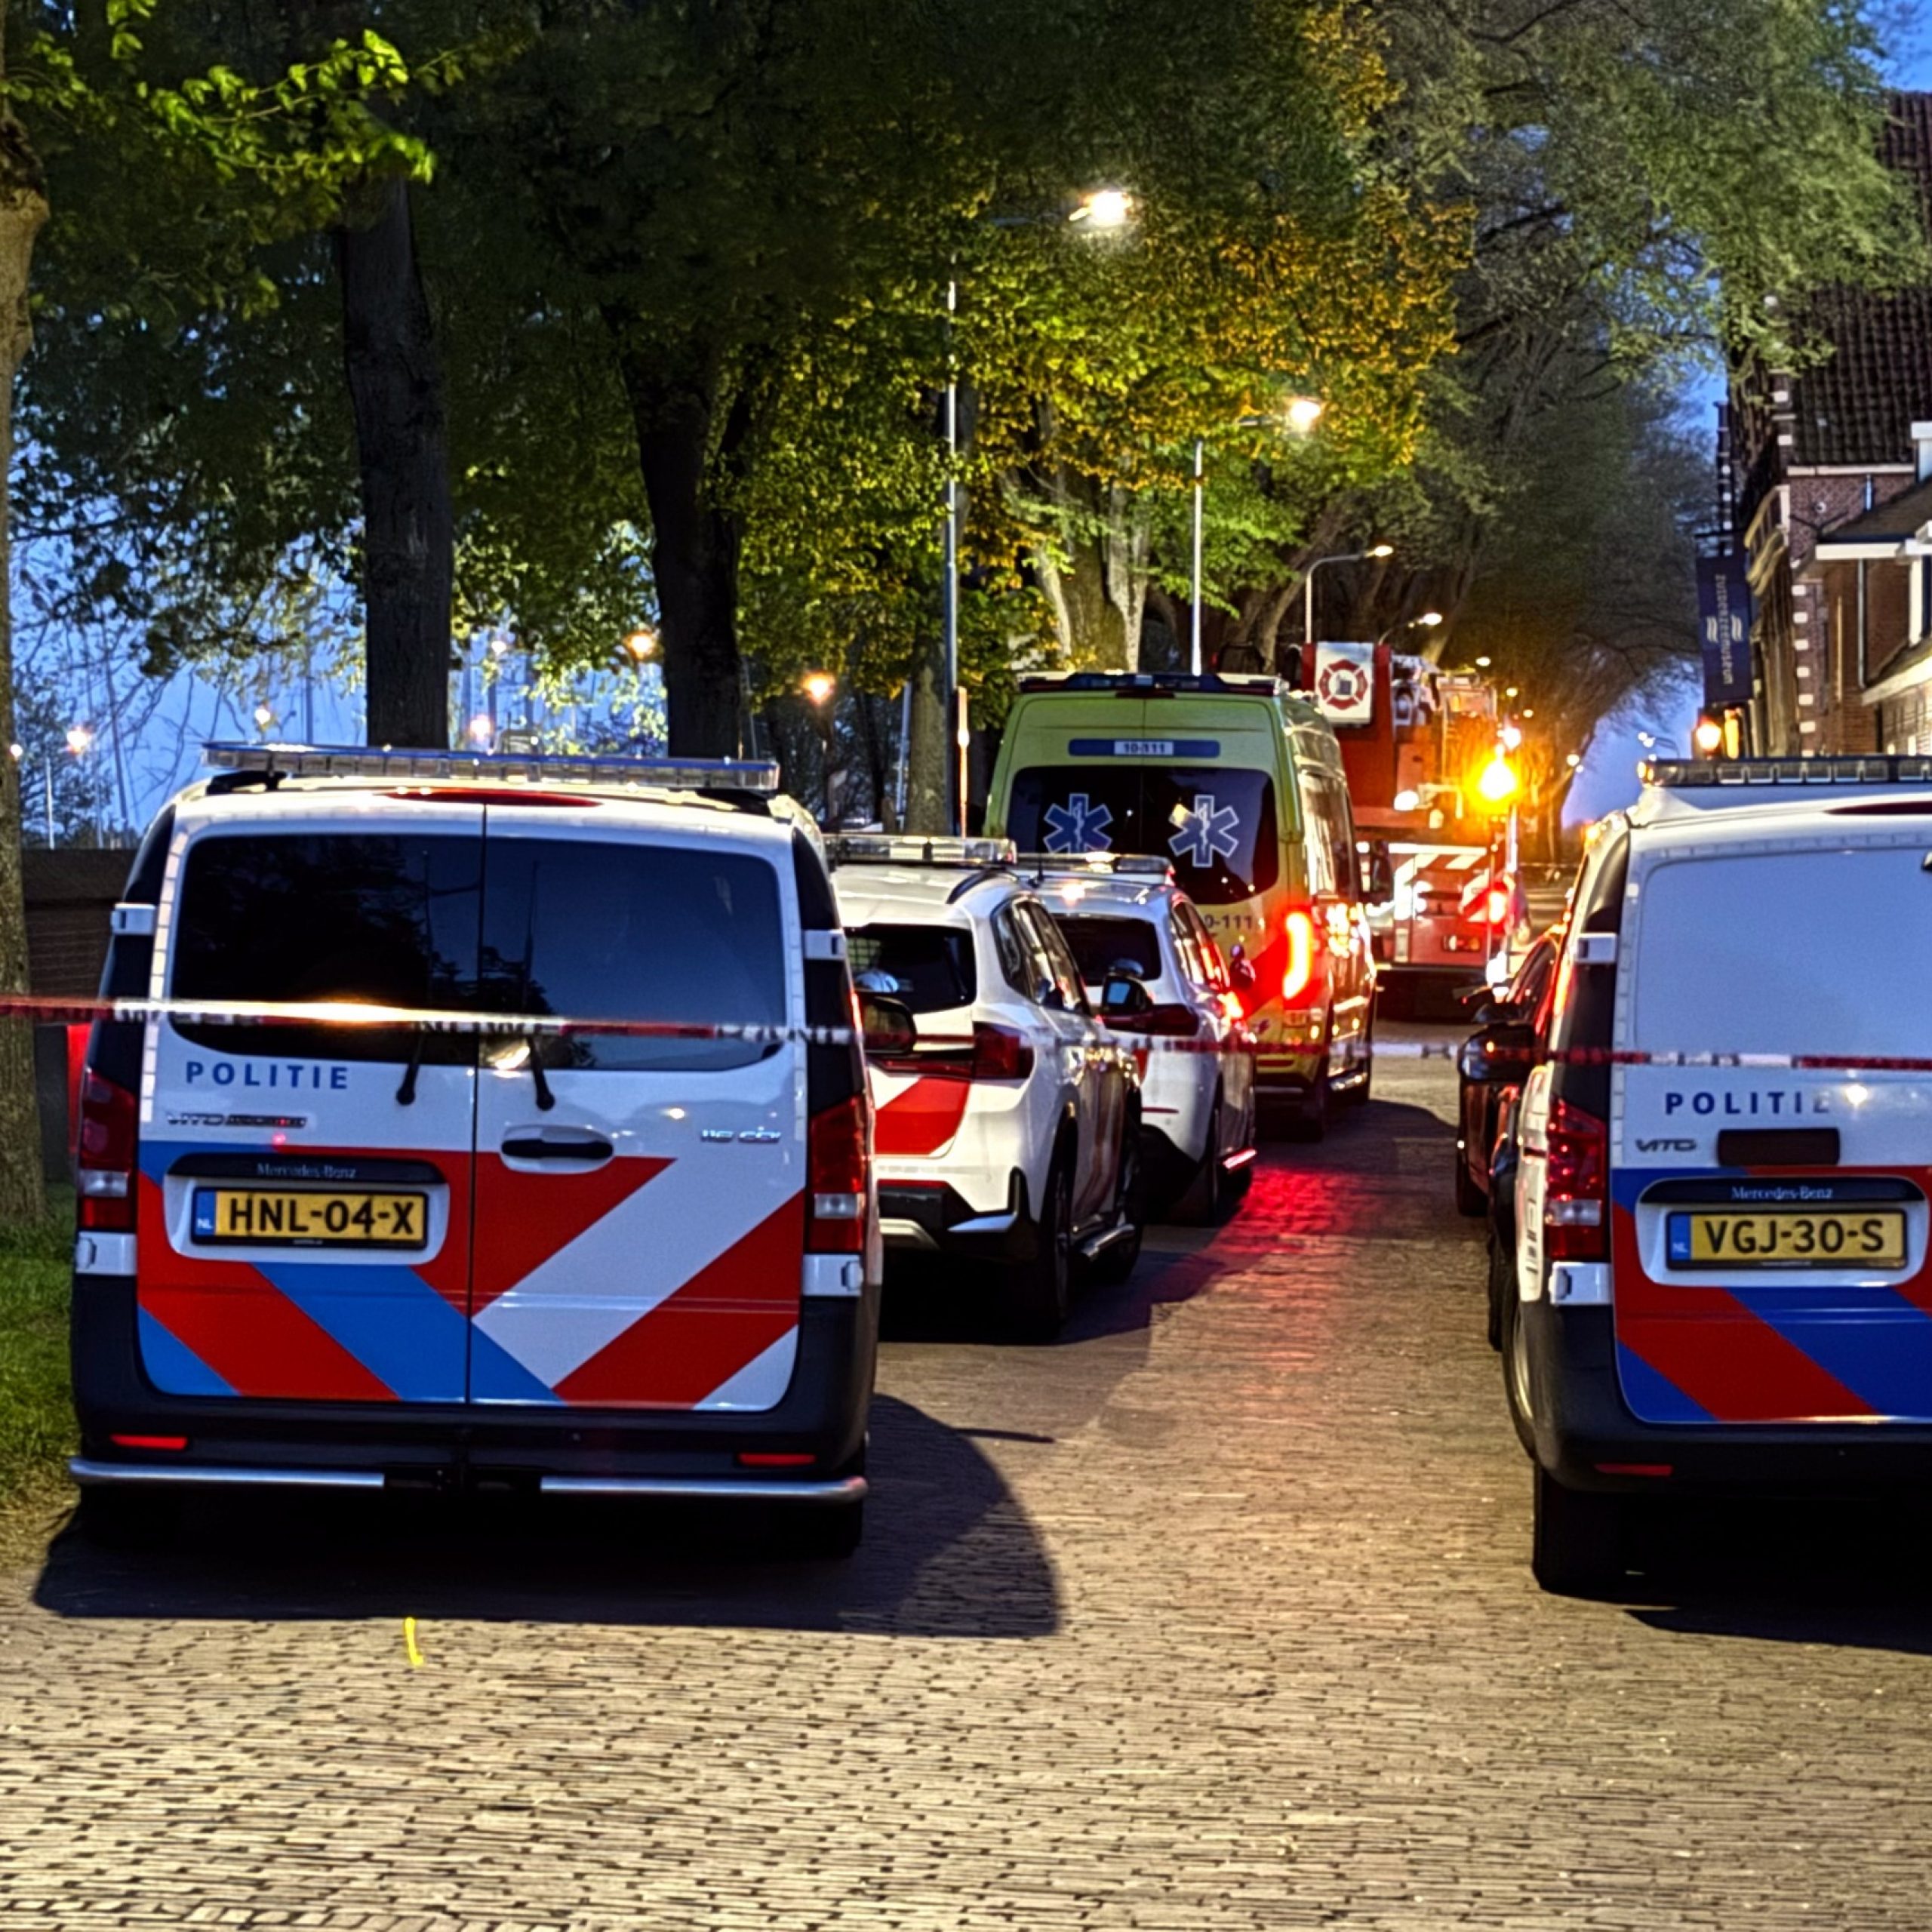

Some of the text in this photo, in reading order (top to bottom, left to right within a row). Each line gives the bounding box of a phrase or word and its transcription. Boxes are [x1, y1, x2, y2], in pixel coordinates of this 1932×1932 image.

[1204, 913, 1253, 931] 0-111
[186, 1060, 348, 1090] POLITIE
[1635, 1138, 1697, 1152] VITO
[1731, 1186, 1834, 1201] Mercedes-Benz
[196, 1197, 415, 1235] NL HNL-04-X
[1672, 1219, 1885, 1254] NL VGJ-30-S
